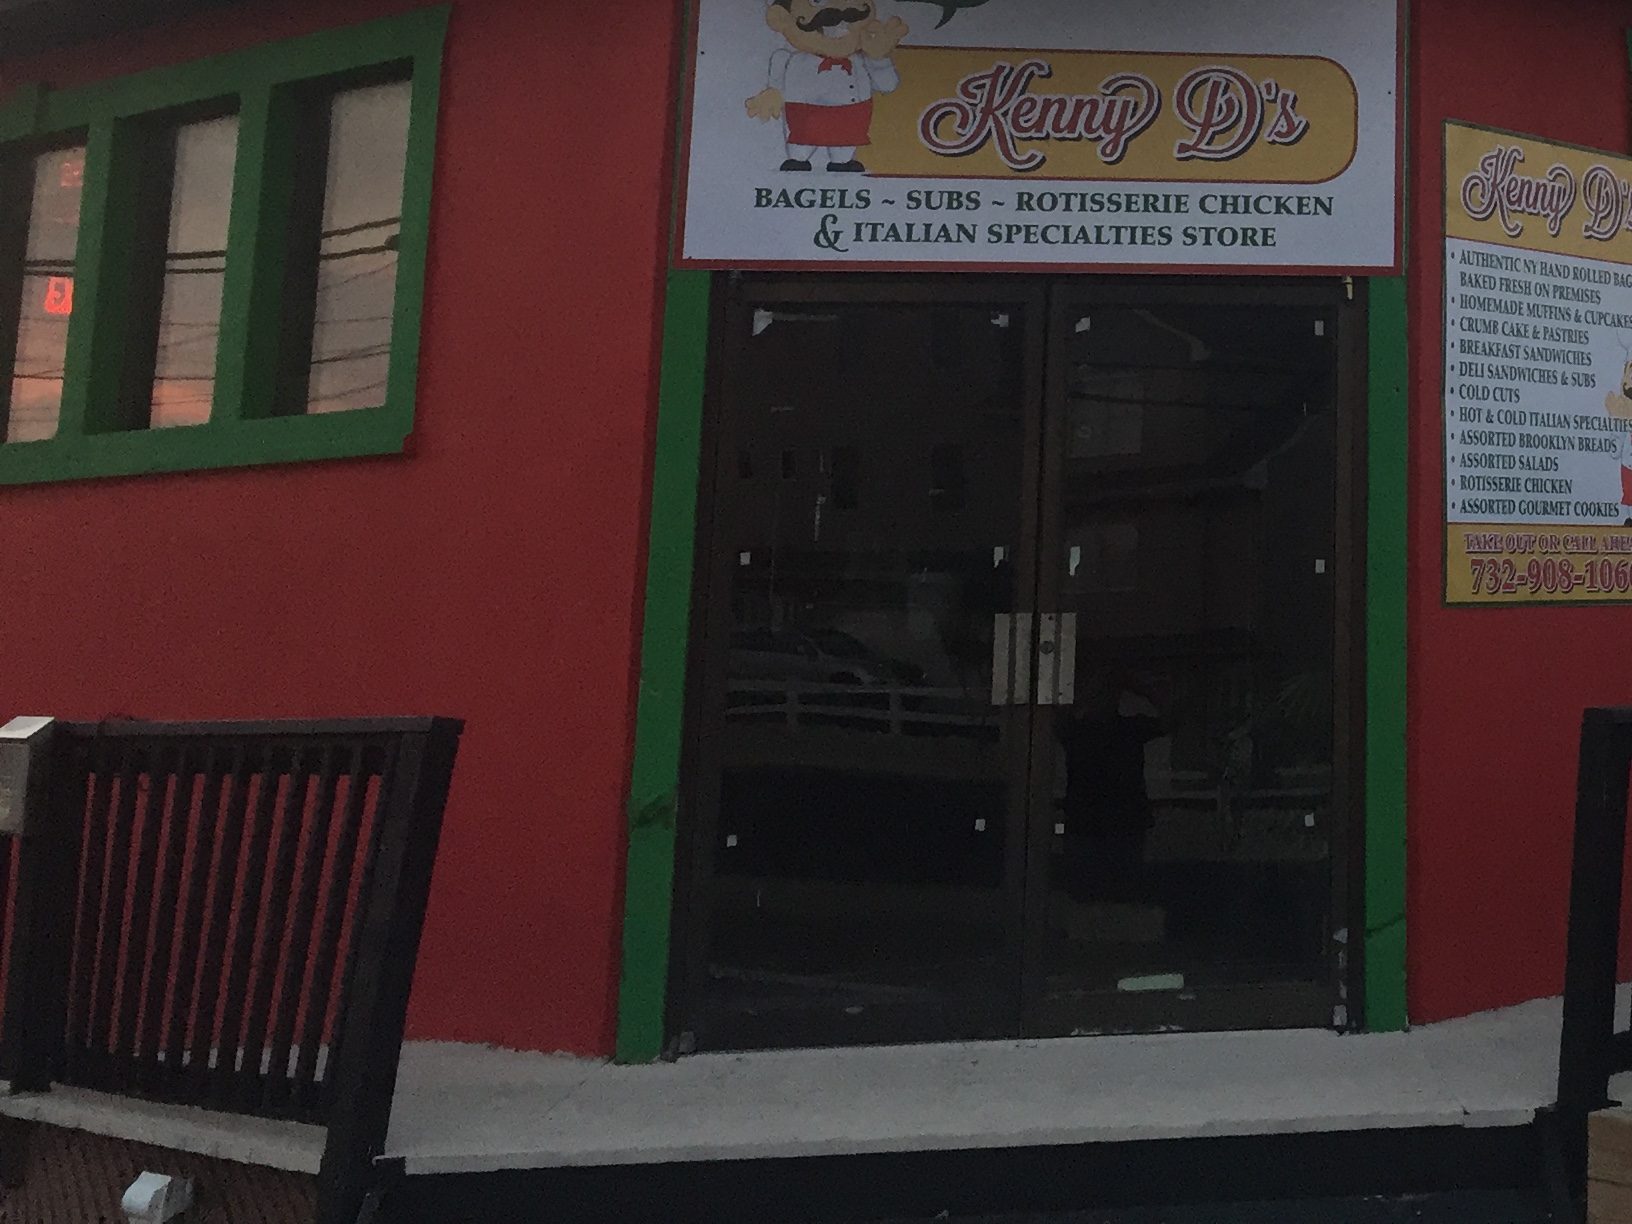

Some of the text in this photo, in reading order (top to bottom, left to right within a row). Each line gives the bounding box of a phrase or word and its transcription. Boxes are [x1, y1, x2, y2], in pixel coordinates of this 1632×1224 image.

[917, 57, 1309, 171] Kenny D's
[754, 187, 1334, 216] BAGELS SUBS ROTISSERIE CHICKEN
[1460, 144, 1576, 237] Kenny
[813, 213, 1277, 252] & ITALIAN SPECIALTIES STORE
[1459, 249, 1521, 271] AUTHENTIC
[1524, 259, 1539, 275] NY
[1540, 262, 1570, 280] HAND
[1572, 267, 1611, 285] ROLLED
[1460, 271, 1602, 305] BAKED FRESH ON PREMISES
[1460, 293, 1525, 316] HOMEMADE
[1527, 303, 1572, 322] MUFFINS
[1573, 309, 1582, 323] &
[1460, 316, 1589, 345] CRUMB CAKE & PASTRIES
[1460, 339, 1592, 366] BREAKFAST SANDWICHES
[1459, 361, 1596, 388] DELI SANDWICHES & SUBS
[1459, 384, 1520, 403] COLD CUTS
[1459, 406, 1483, 423] HOT
[1485, 409, 1494, 423] &
[1497, 409, 1527, 426] COLD
[1529, 412, 1572, 429] ITALIAN
[1459, 429, 1617, 453] ASSORTED BROOKLYN BREADS
[1459, 453, 1559, 472] ASSORTED SALADS
[1460, 475, 1573, 494] ROTISSERIE CHICKEN
[1460, 498, 1619, 517] ASSORTED GOURMET COOKIES
[1464, 532, 1503, 553] TAKE
[1505, 533, 1536, 554] OUT
[1538, 533, 1560, 554] OR
[1562, 534, 1598, 554] CALL
